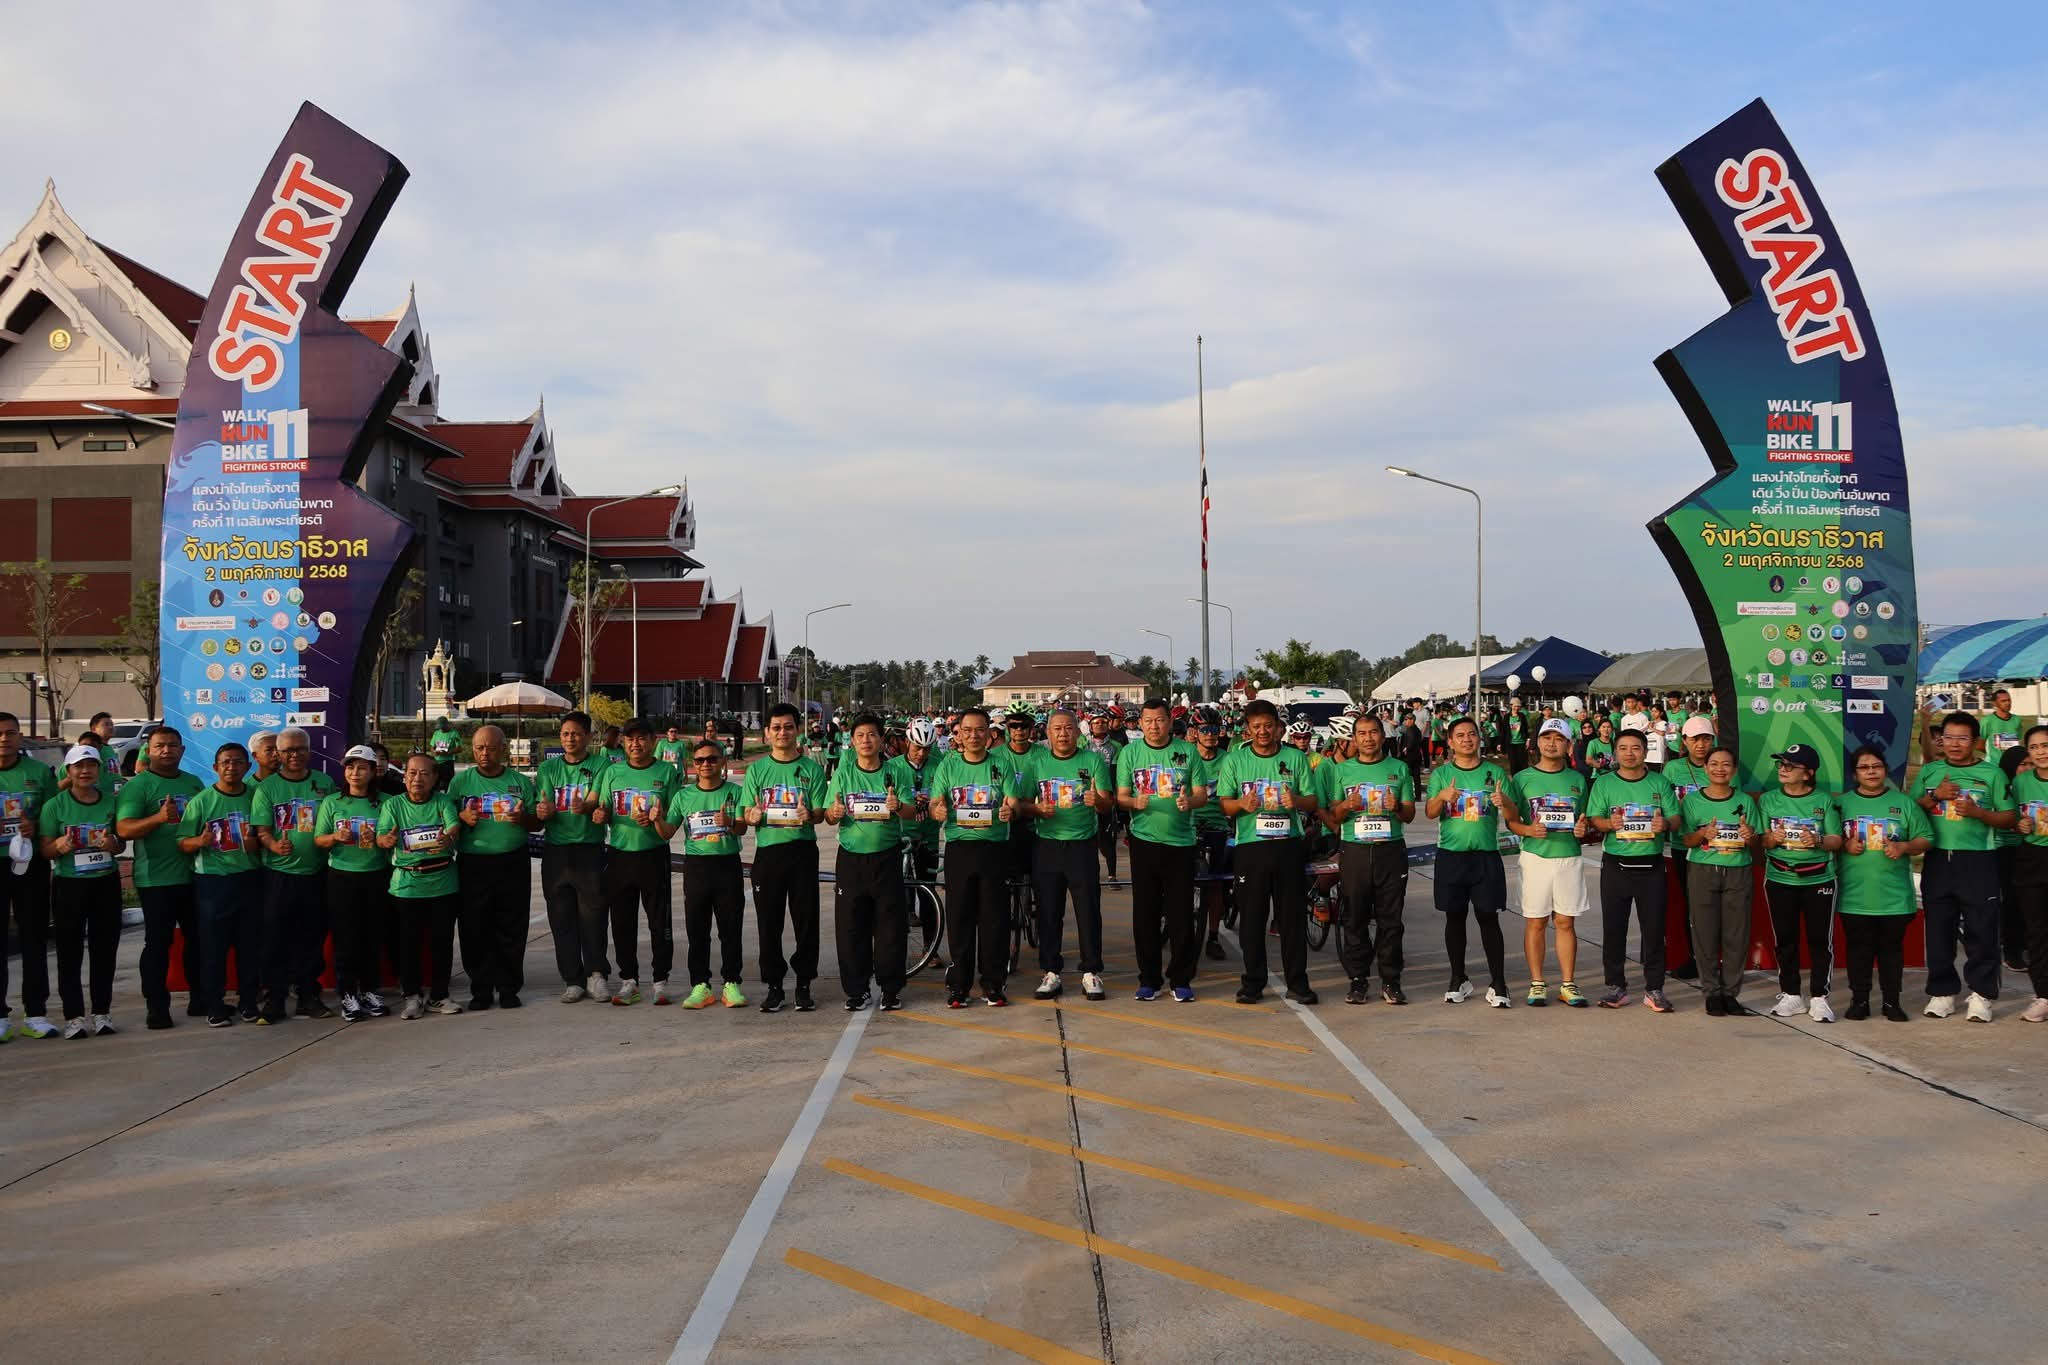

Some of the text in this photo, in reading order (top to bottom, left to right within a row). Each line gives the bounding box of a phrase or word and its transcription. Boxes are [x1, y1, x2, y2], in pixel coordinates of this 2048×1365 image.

[1718, 151, 1862, 361] START
[212, 156, 350, 389] START
[1767, 400, 1812, 412] WALK
[222, 409, 267, 422] WALK
[1767, 413, 1814, 431] RUN
[221, 424, 268, 442] RUN
[1812, 401, 1852, 450] 11
[267, 408, 308, 459] 11
[1767, 434, 1813, 450] BIKE
[221, 444, 268, 461] BIKE
[1769, 452, 1851, 461] FIGHTING STROKE
[224, 462, 307, 472] FIGHTING STROKE
[1752, 469, 1858, 484] แสงนำใจไทยทั้งชาติ
[193, 479, 299, 496] แสงนำใจไทยทั้งชาติ
[1752, 485, 1890, 501] เดิน วิ่ง ปั่น ป้องกันอัมพาต
[193, 497, 333, 512] เดิน วิ่ง ปั่น ป้องกันอัมพาต
[1752, 501, 1880, 517] ครั้งที่ 11 เฉลิมพระเกียรติ
[193, 514, 323, 528] ครั้งที่ 11 เฉลิมพระเกียรติ
[1701, 522, 1885, 549] จังหวัดนราธิวาส
[183, 535, 369, 561] จังหวัดนราธิวาส
[1723, 552, 1864, 570] 2 พฤศจิกายน 2568
[205, 563, 348, 585] 2 พฤศจิกายน 2568
[229, 696, 247, 704] RUN
[1785, 701, 1808, 713] ptt
[223, 716, 245, 728] ptt
[864, 804, 880, 812] 220
[968, 811, 980, 819] 40
[700, 818, 714, 826] 132
[1263, 821, 1285, 829] 4867
[1363, 823, 1382, 831] 3212
[1623, 823, 1646, 831] 8837
[418, 832, 437, 841] 4312
[88, 854, 104, 863] 149
